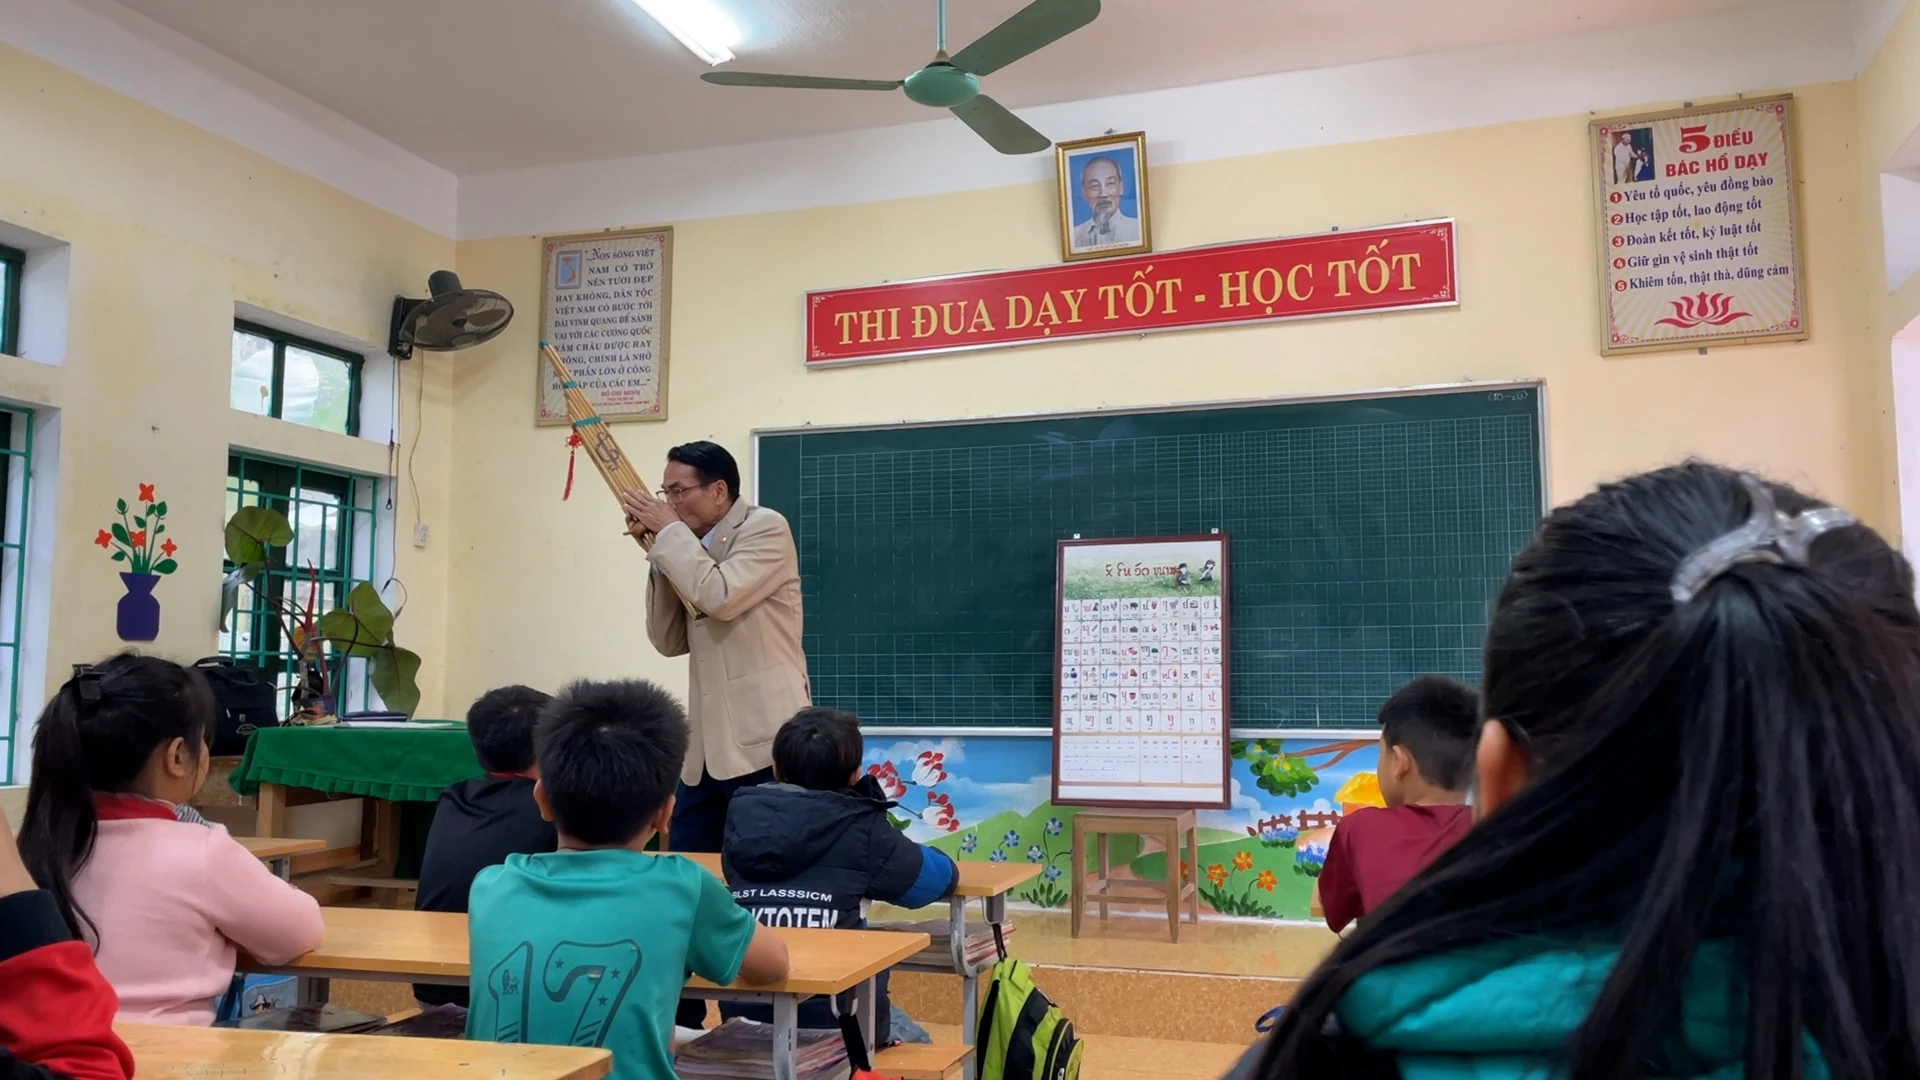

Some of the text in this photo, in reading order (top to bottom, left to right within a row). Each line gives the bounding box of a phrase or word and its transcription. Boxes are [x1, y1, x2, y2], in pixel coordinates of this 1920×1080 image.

[1679, 125, 1753, 154] 5 ĐIỀU
[1665, 152, 1768, 177] BÁC HỒ DẠY
[1624, 190, 1646, 202] Yêu
[1663, 181, 1694, 200] quốc,
[1697, 181, 1717, 197] yêu
[1720, 175, 1749, 192] đồng
[1752, 175, 1774, 188] bào
[1625, 212, 1648, 225] Học
[1651, 209, 1669, 223] tập
[1672, 203, 1691, 218] tốt,
[1694, 205, 1711, 216] lao
[1714, 200, 1743, 216] động
[1746, 195, 1762, 210] tốt
[1626, 233, 1656, 246] Đoàn
[1659, 227, 1677, 242] kết
[1680, 225, 1700, 240] tốt,
[1720, 223, 1743, 238] luật
[1746, 218, 1762, 233] tốt
[635, 247, 655, 258] VIỆT
[1652, 253, 1670, 268] gìn
[1673, 250, 1687, 265] vệ
[1688, 249, 1713, 262] sinh
[1716, 246, 1739, 260] thật
[1742, 241, 1759, 256] tốt
[588, 265, 609, 275] NAM
[615, 263, 628, 272] CÓ
[1630, 275, 1664, 289] Khiêm
[1667, 271, 1687, 285] tốn,
[1689, 270, 1711, 285] thật
[1714, 268, 1734, 281] thà,
[1737, 266, 1764, 280] dũng
[1767, 263, 1790, 276] cảm
[556, 294, 574, 303] HAY
[576, 290, 612, 302] KHÔNG,
[635, 288, 654, 299] TỘC
[835, 307, 901, 345] THI
[911, 299, 995, 338] ĐUA
[1005, 288, 1087, 336] DẠY
[1098, 264, 1182, 320] TỐT
[1218, 263, 1314, 316] HỌC
[1327, 238, 1421, 297] TỐT
[555, 306, 575, 317] VIỆT
[577, 304, 596, 315] NAM
[597, 302, 610, 312] CÓ
[569, 317, 589, 328] VINH
[590, 315, 618, 327] QUANG
[554, 331, 567, 341] VAI
[584, 327, 600, 339] CÁC
[632, 339, 652, 348] HAY
[588, 352, 617, 364] CHÍNH
[626, 364, 651, 374] CÔNG
[608, 377, 626, 388] CÁC
[759, 888, 832, 902] LASSSICM
[488, 938, 643, 1047] 17
